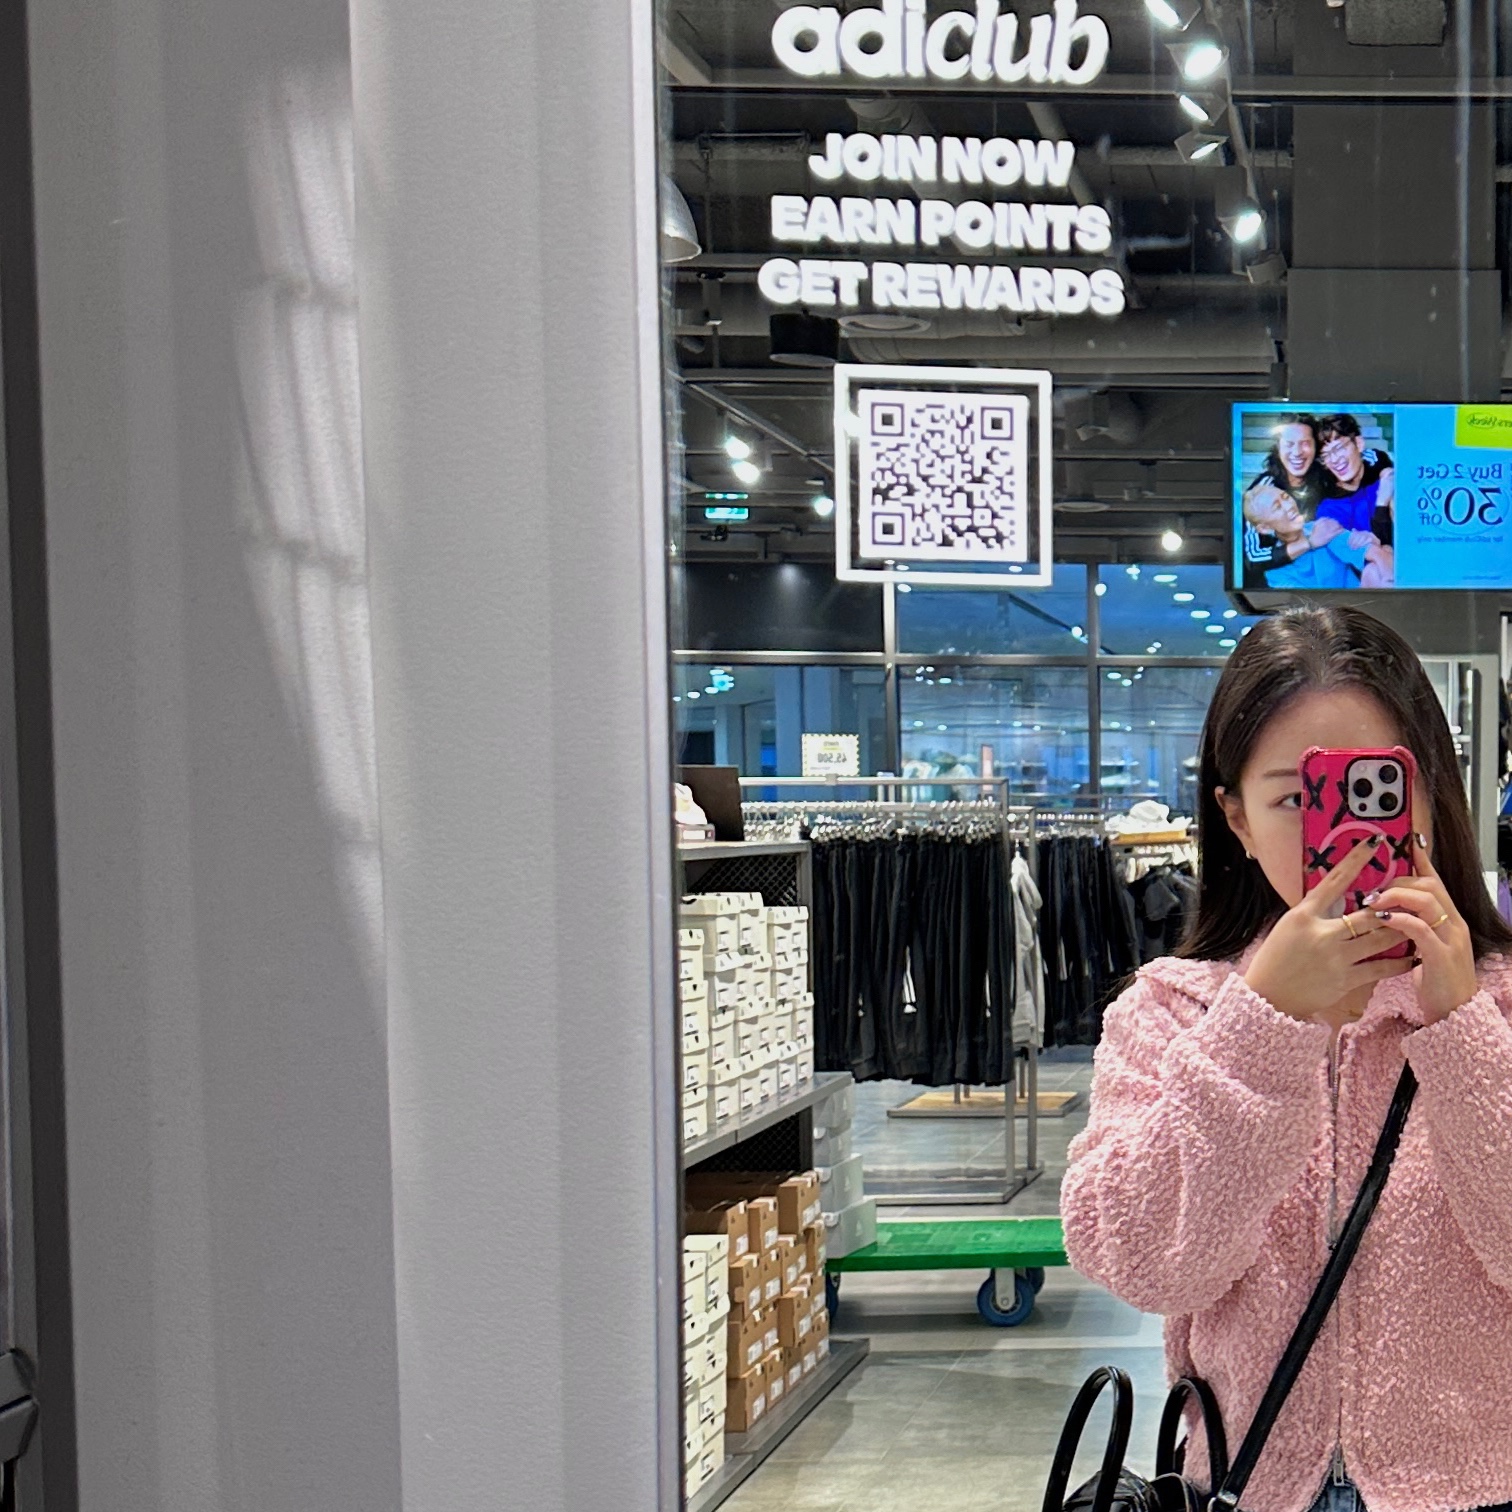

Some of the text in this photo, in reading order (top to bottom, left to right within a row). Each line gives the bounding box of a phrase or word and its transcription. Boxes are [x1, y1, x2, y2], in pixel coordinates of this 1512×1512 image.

[772, 0, 1110, 84] adiclub
[808, 132, 1076, 187] JOIN NOW
[770, 194, 1113, 253] EARN POINTS
[758, 257, 1127, 316] GET REWARDS
